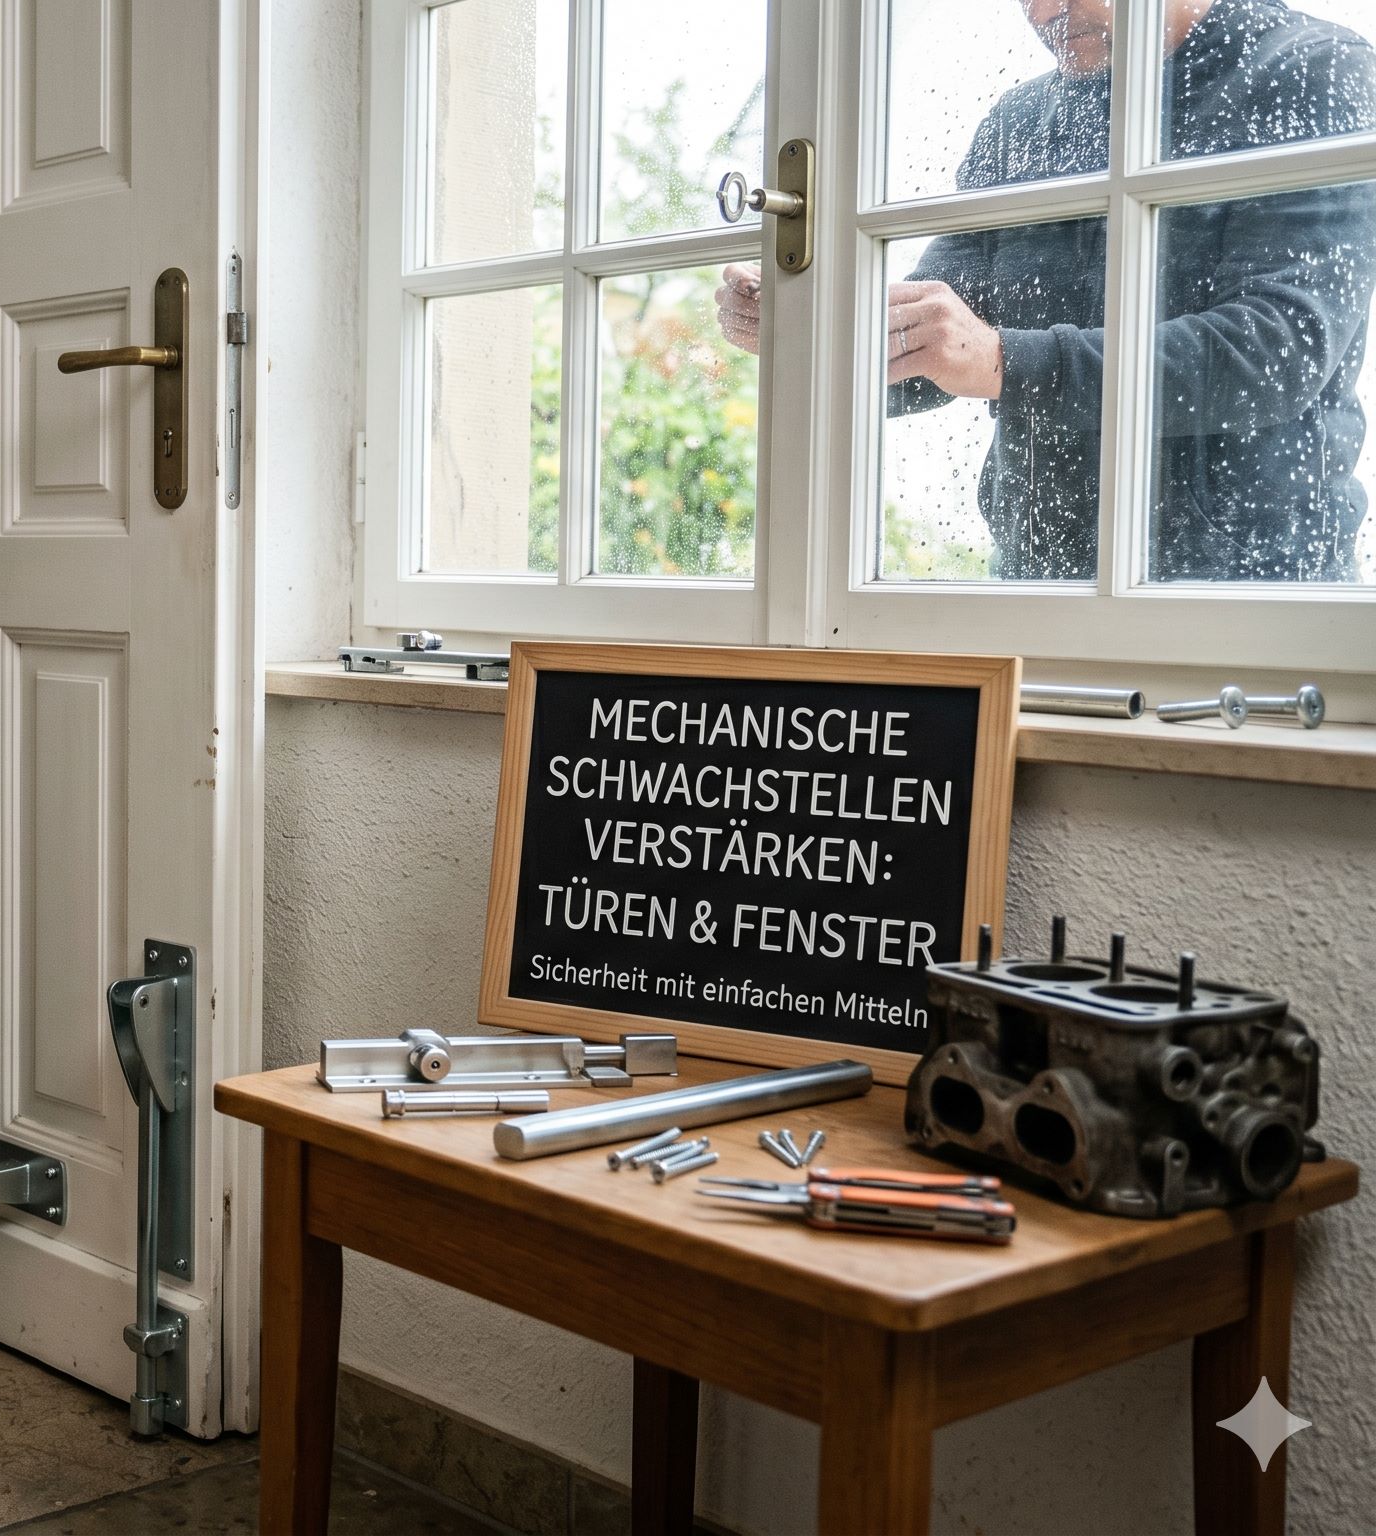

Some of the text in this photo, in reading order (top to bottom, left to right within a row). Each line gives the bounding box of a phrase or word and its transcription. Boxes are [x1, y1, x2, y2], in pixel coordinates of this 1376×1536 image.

[589, 697, 910, 757] MECHANISCHE
[546, 755, 952, 825] SCHWACHSTELLEN
[584, 817, 893, 885] VERSTÄRKEN:
[538, 876, 938, 967] TÜREN & FENSTER
[530, 954, 648, 993] Sicherheit
[655, 973, 696, 999] mit
[702, 978, 825, 1016] einfachen
[834, 990, 928, 1029] Mitteln
